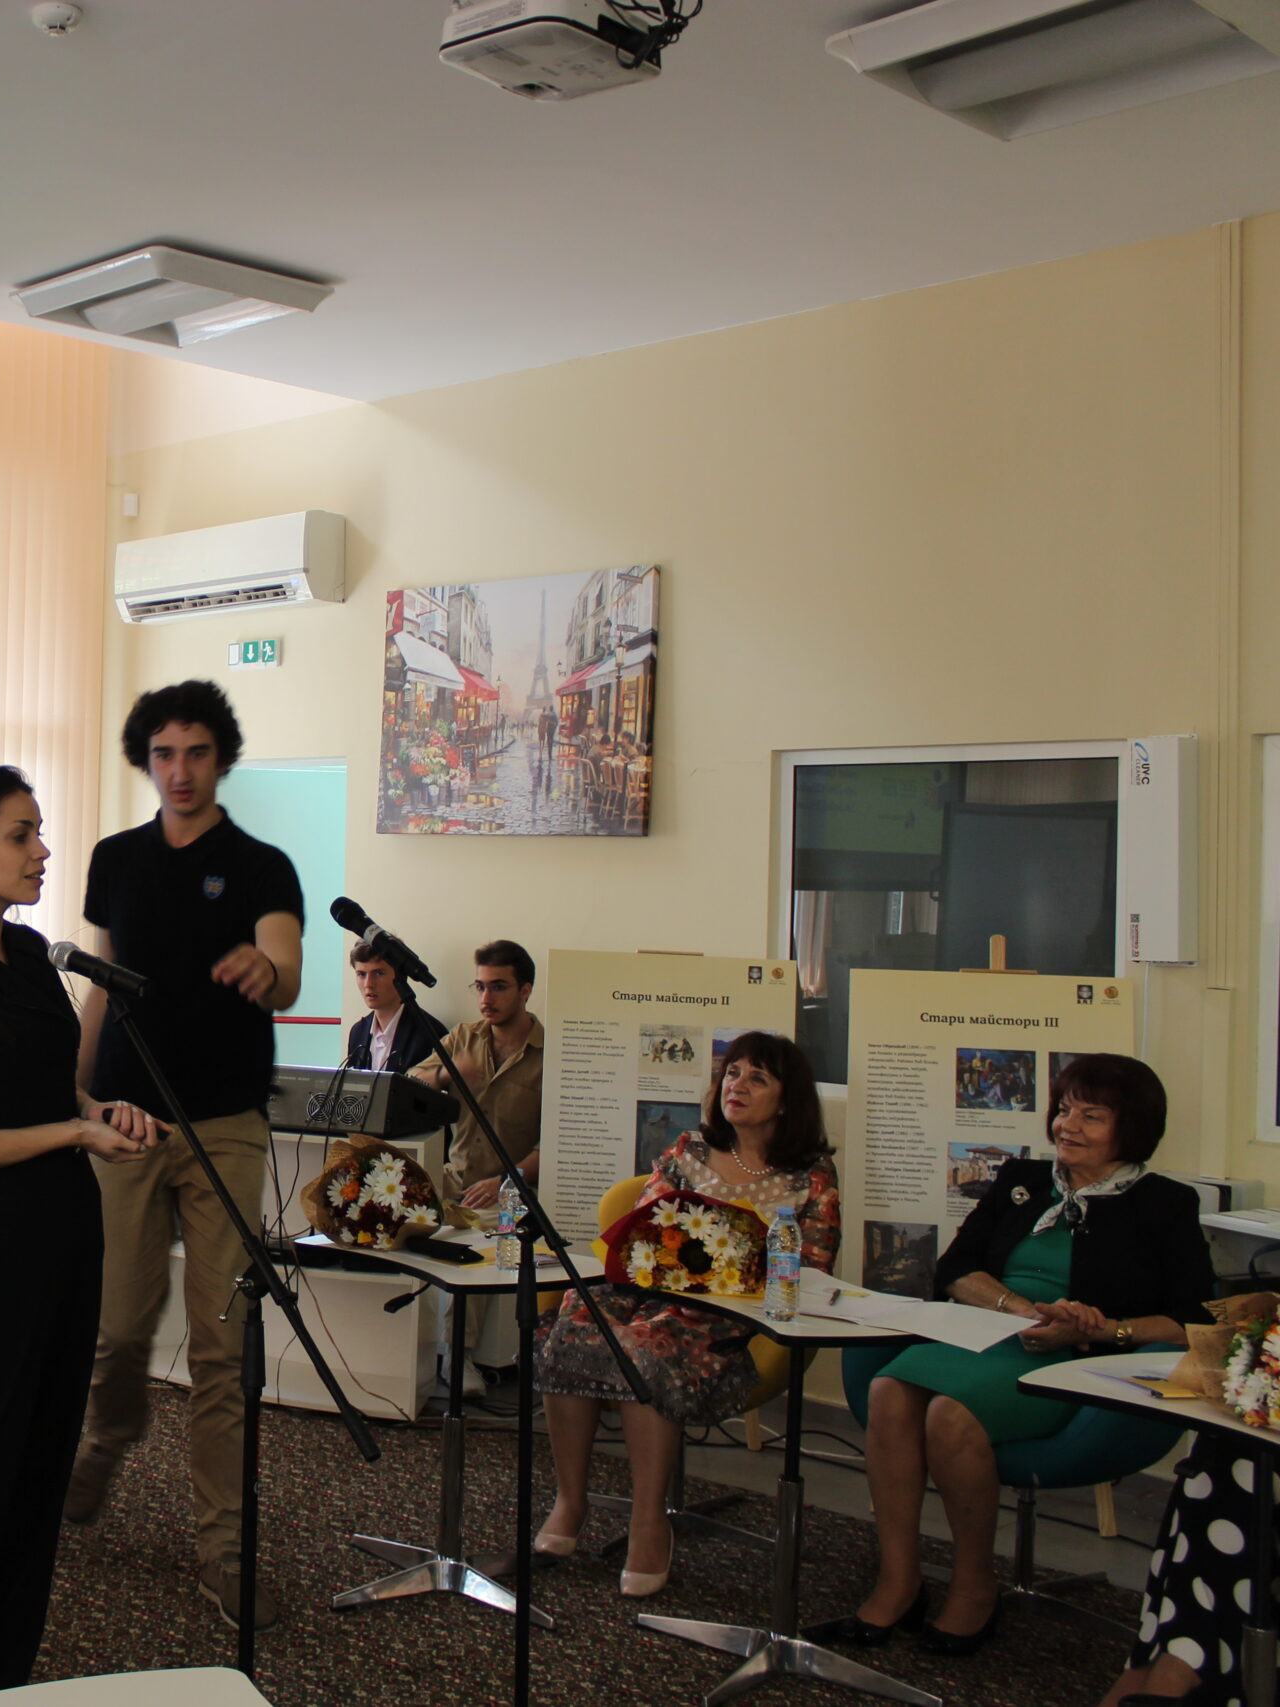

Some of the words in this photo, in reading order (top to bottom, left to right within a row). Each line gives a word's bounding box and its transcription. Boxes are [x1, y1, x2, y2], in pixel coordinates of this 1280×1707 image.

[612, 990, 652, 1004] Стари
[655, 993, 718, 1007] майстори
[721, 995, 730, 1005] II
[920, 1012, 965, 1026] Стари
[969, 1014, 1040, 1029] майстори
[1044, 1016, 1059, 1028] III
